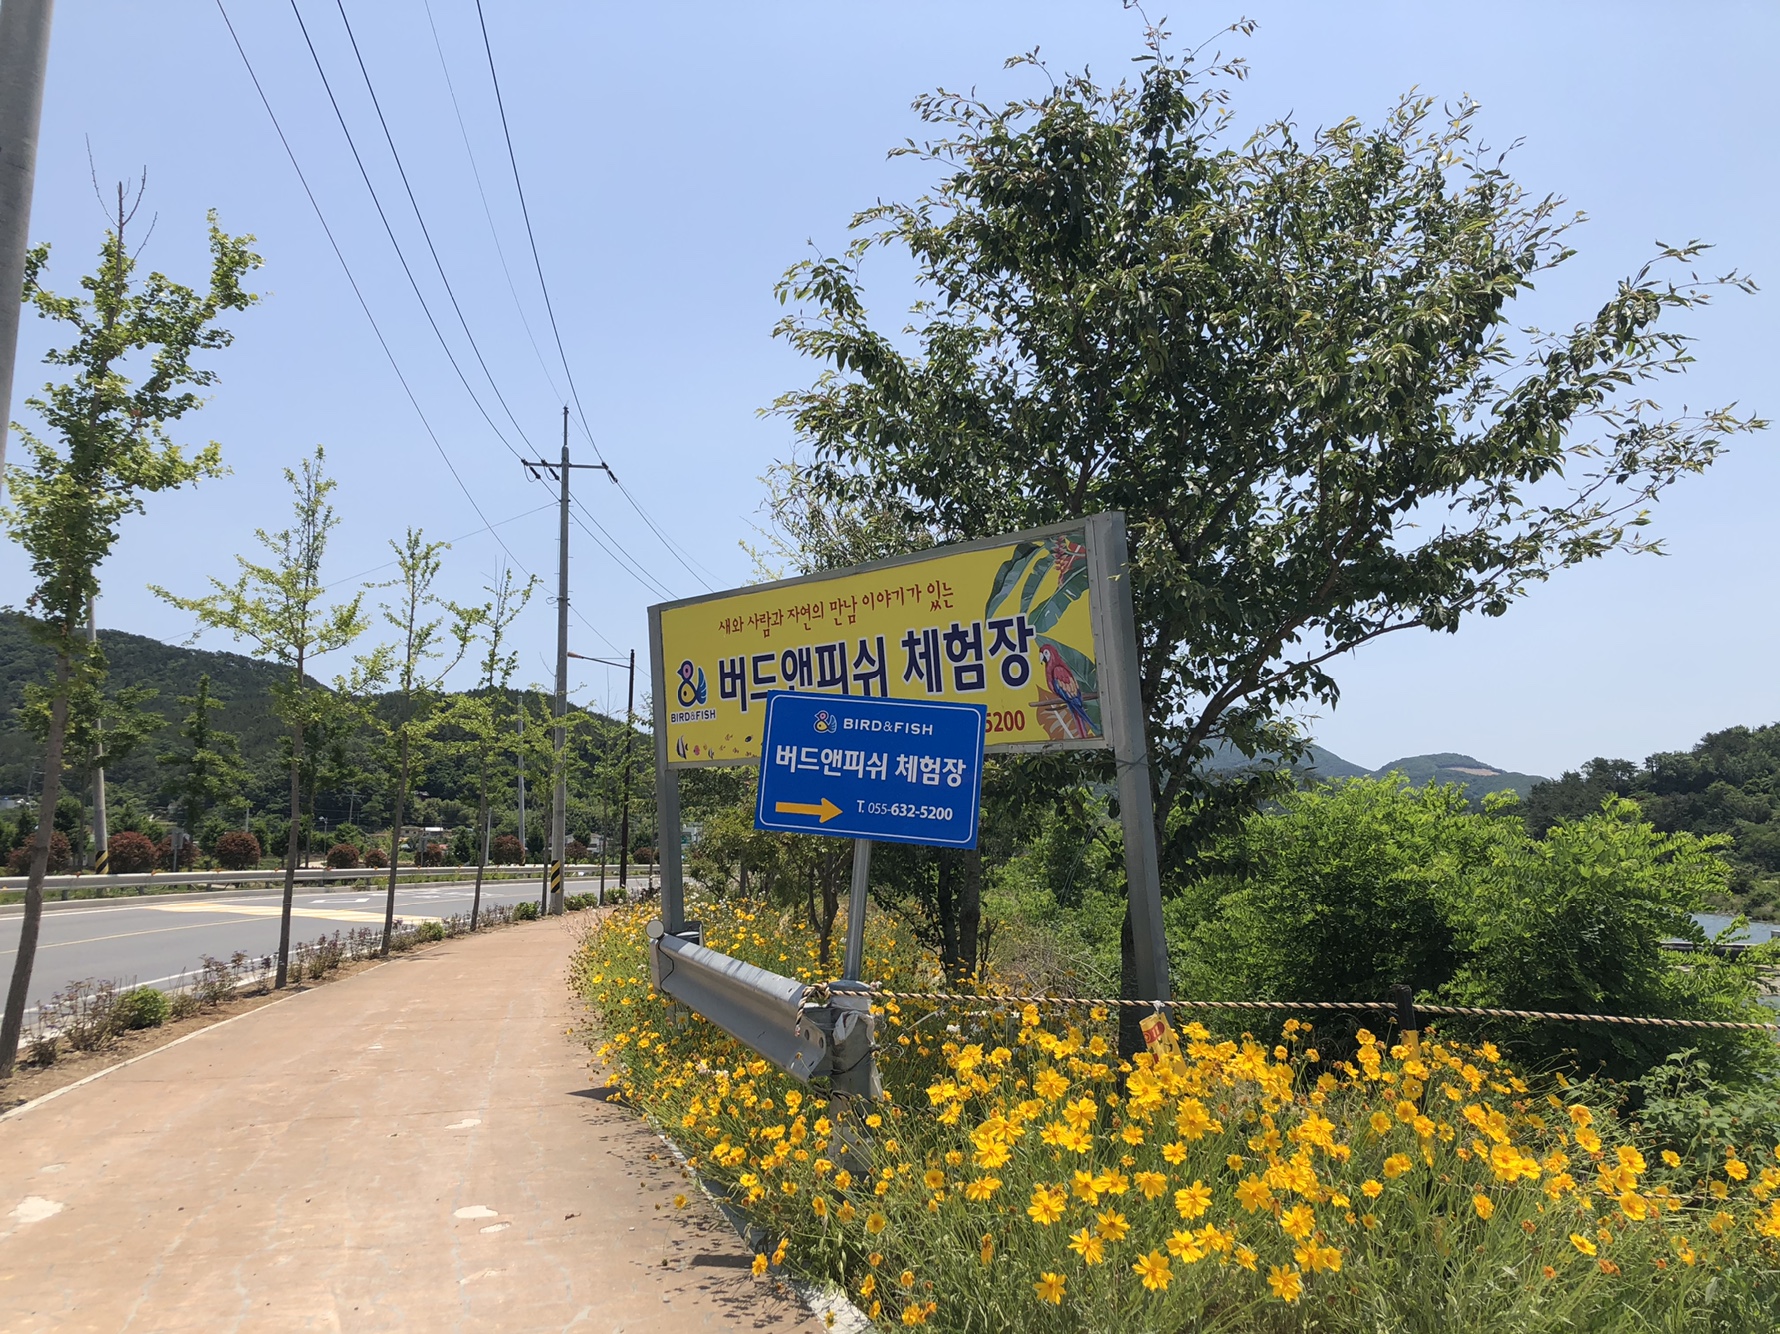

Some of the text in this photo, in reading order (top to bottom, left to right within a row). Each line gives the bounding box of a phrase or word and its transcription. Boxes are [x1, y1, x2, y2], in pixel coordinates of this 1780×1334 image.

[718, 580, 954, 638] 새와 사람과 자연의 만남 이야기가 있는
[719, 616, 1034, 712] 버드앤피쉬 체험장
[671, 709, 716, 723] BIRD&FISH
[843, 718, 934, 736] BIRD&FISH
[775, 745, 967, 788] 버드앤피쉬 체험장
[857, 800, 953, 821] T. 055-632-5200
